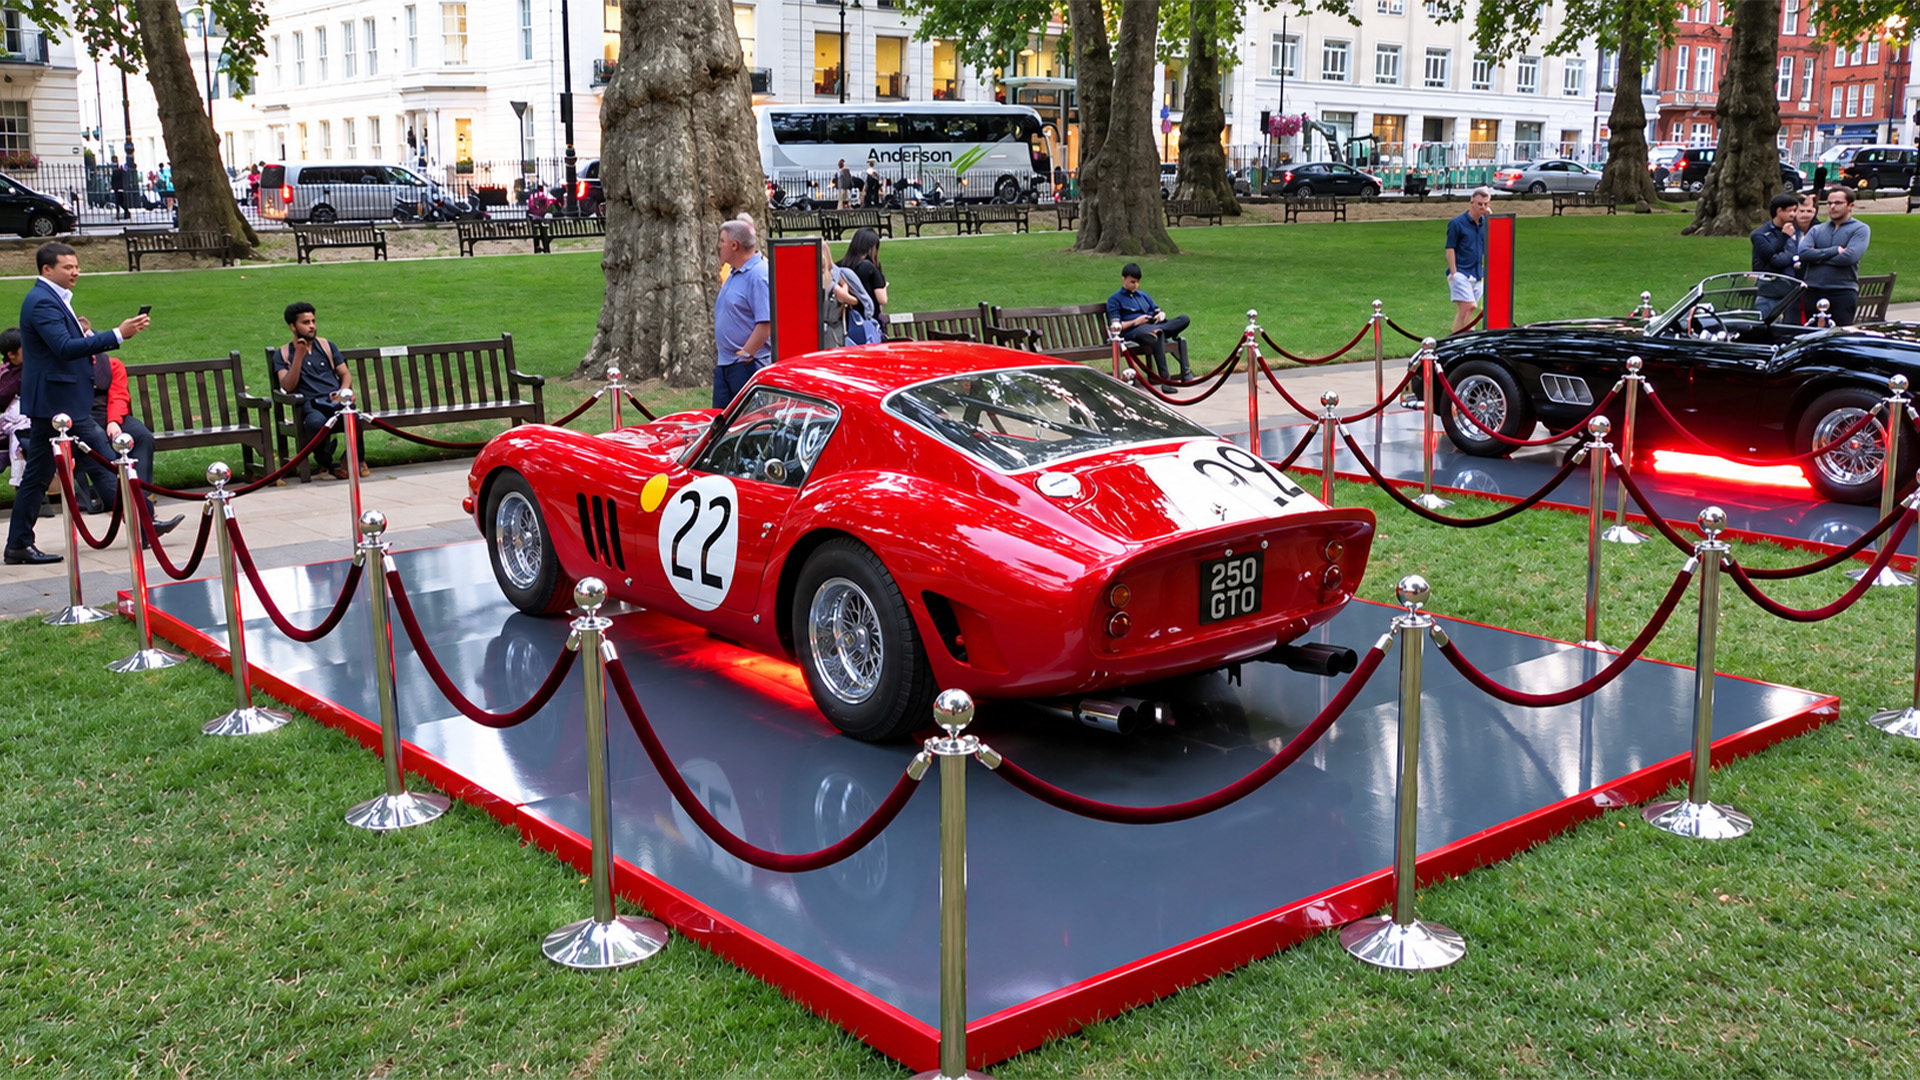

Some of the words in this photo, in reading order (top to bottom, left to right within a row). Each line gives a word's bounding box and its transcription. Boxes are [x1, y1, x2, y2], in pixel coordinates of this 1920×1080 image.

[868, 147, 952, 163] Anderson
[671, 490, 732, 590] 22
[1211, 557, 1257, 591] 250
[1211, 586, 1256, 619] GTO
